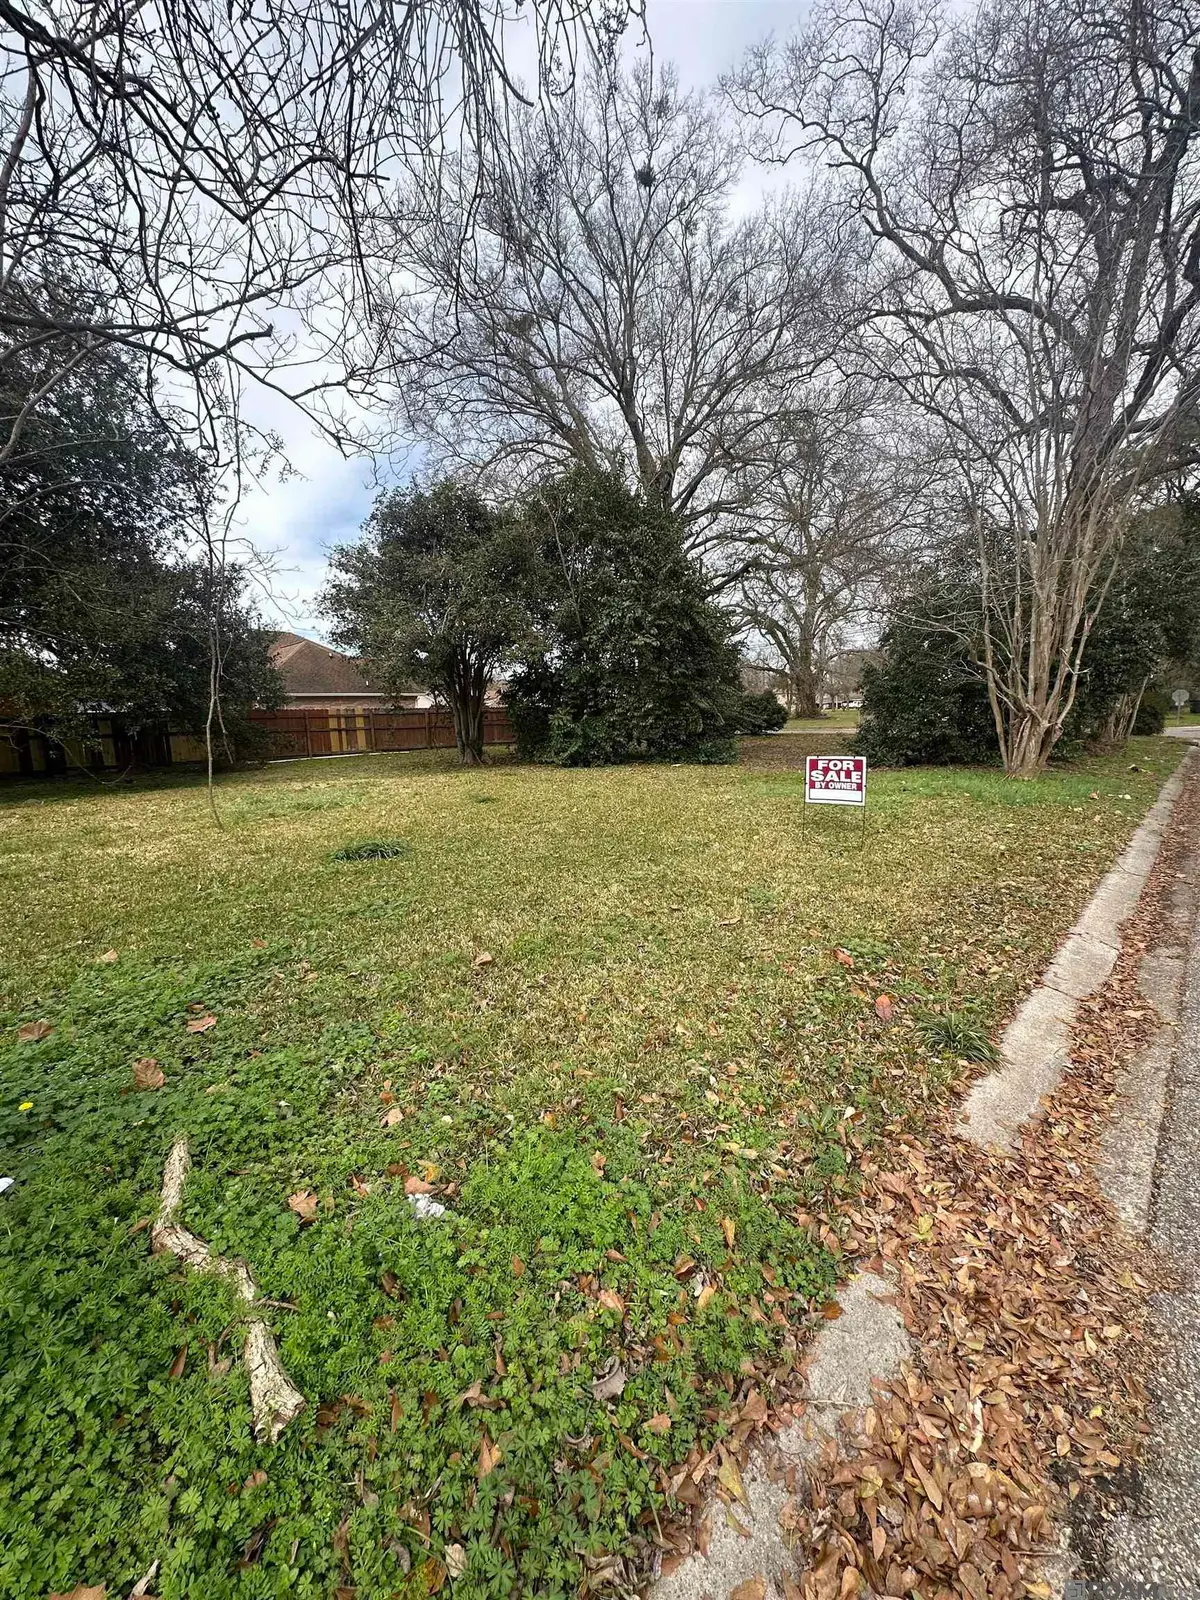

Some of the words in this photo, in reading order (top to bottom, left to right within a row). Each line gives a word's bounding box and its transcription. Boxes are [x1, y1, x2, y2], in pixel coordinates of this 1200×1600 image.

[818, 760, 854, 771] FOR
[811, 770, 862, 783] SALE
[828, 782, 857, 790] OWNER
